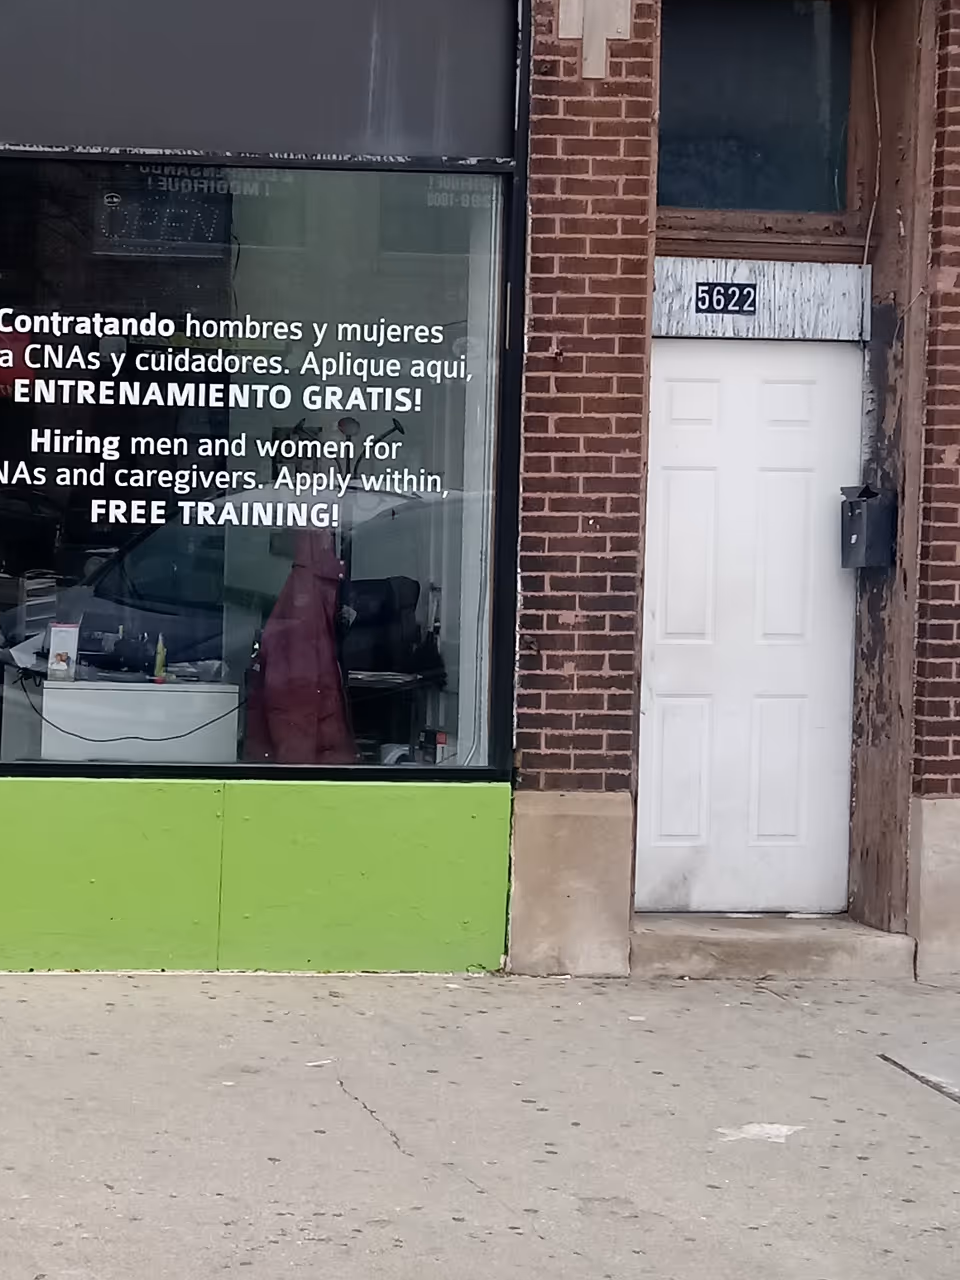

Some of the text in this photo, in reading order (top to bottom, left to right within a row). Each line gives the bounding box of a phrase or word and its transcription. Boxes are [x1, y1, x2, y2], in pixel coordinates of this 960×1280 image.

[100, 207, 220, 241] OPEN
[697, 286, 755, 311] 5622
[186, 313, 302, 339] hombres
[313, 323, 327, 347] y
[338, 318, 443, 347] mujeres
[25, 344, 100, 369] CNAs
[111, 353, 125, 377] y
[136, 348, 289, 373] cuidadores.
[300, 352, 400, 381] Aplique
[15, 379, 291, 408] ENTRENAMIENTO
[303, 386, 421, 411] GRATIS!
[32, 429, 402, 460] Hiring men and women for
[56, 463, 104, 485] and
[115, 465, 263, 493] caregivers.
[274, 466, 351, 497] Apply
[359, 469, 448, 498] within,
[91, 500, 338, 527] FREE TRAINING!
